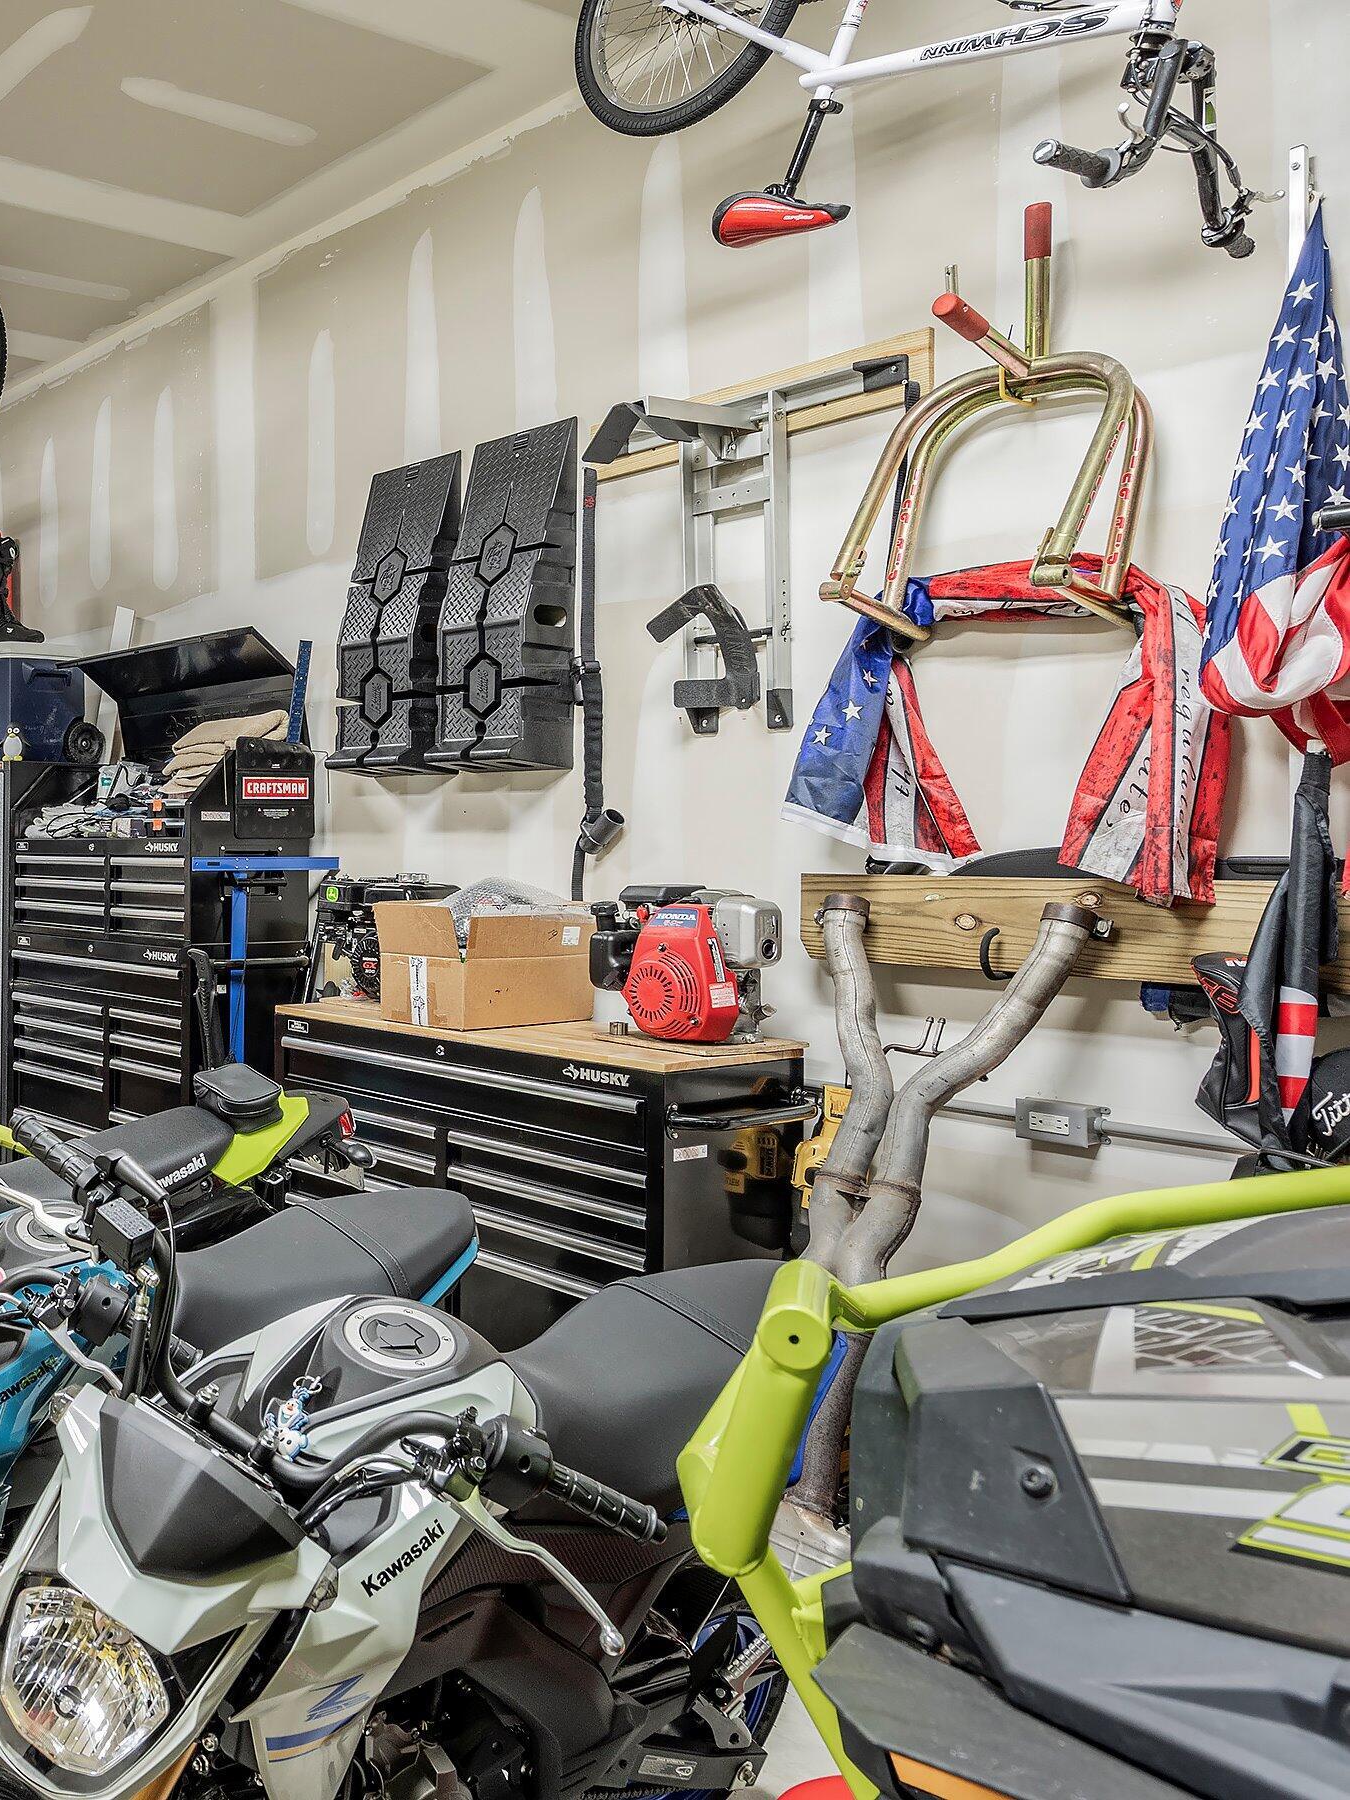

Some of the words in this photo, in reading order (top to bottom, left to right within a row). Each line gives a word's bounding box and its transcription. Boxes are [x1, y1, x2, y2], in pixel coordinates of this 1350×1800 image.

[920, 5, 1117, 60] SCHWINN
[247, 782, 305, 794] CRAFTSMAN
[153, 842, 178, 852] HUSKY
[656, 913, 696, 921] HONDA
[152, 950, 177, 962] HUSKY
[362, 961, 377, 969] GX
[579, 1067, 631, 1087] HUSKY
[156, 1152, 207, 1188] wasaki
[360, 1518, 445, 1598] Kawasaki
